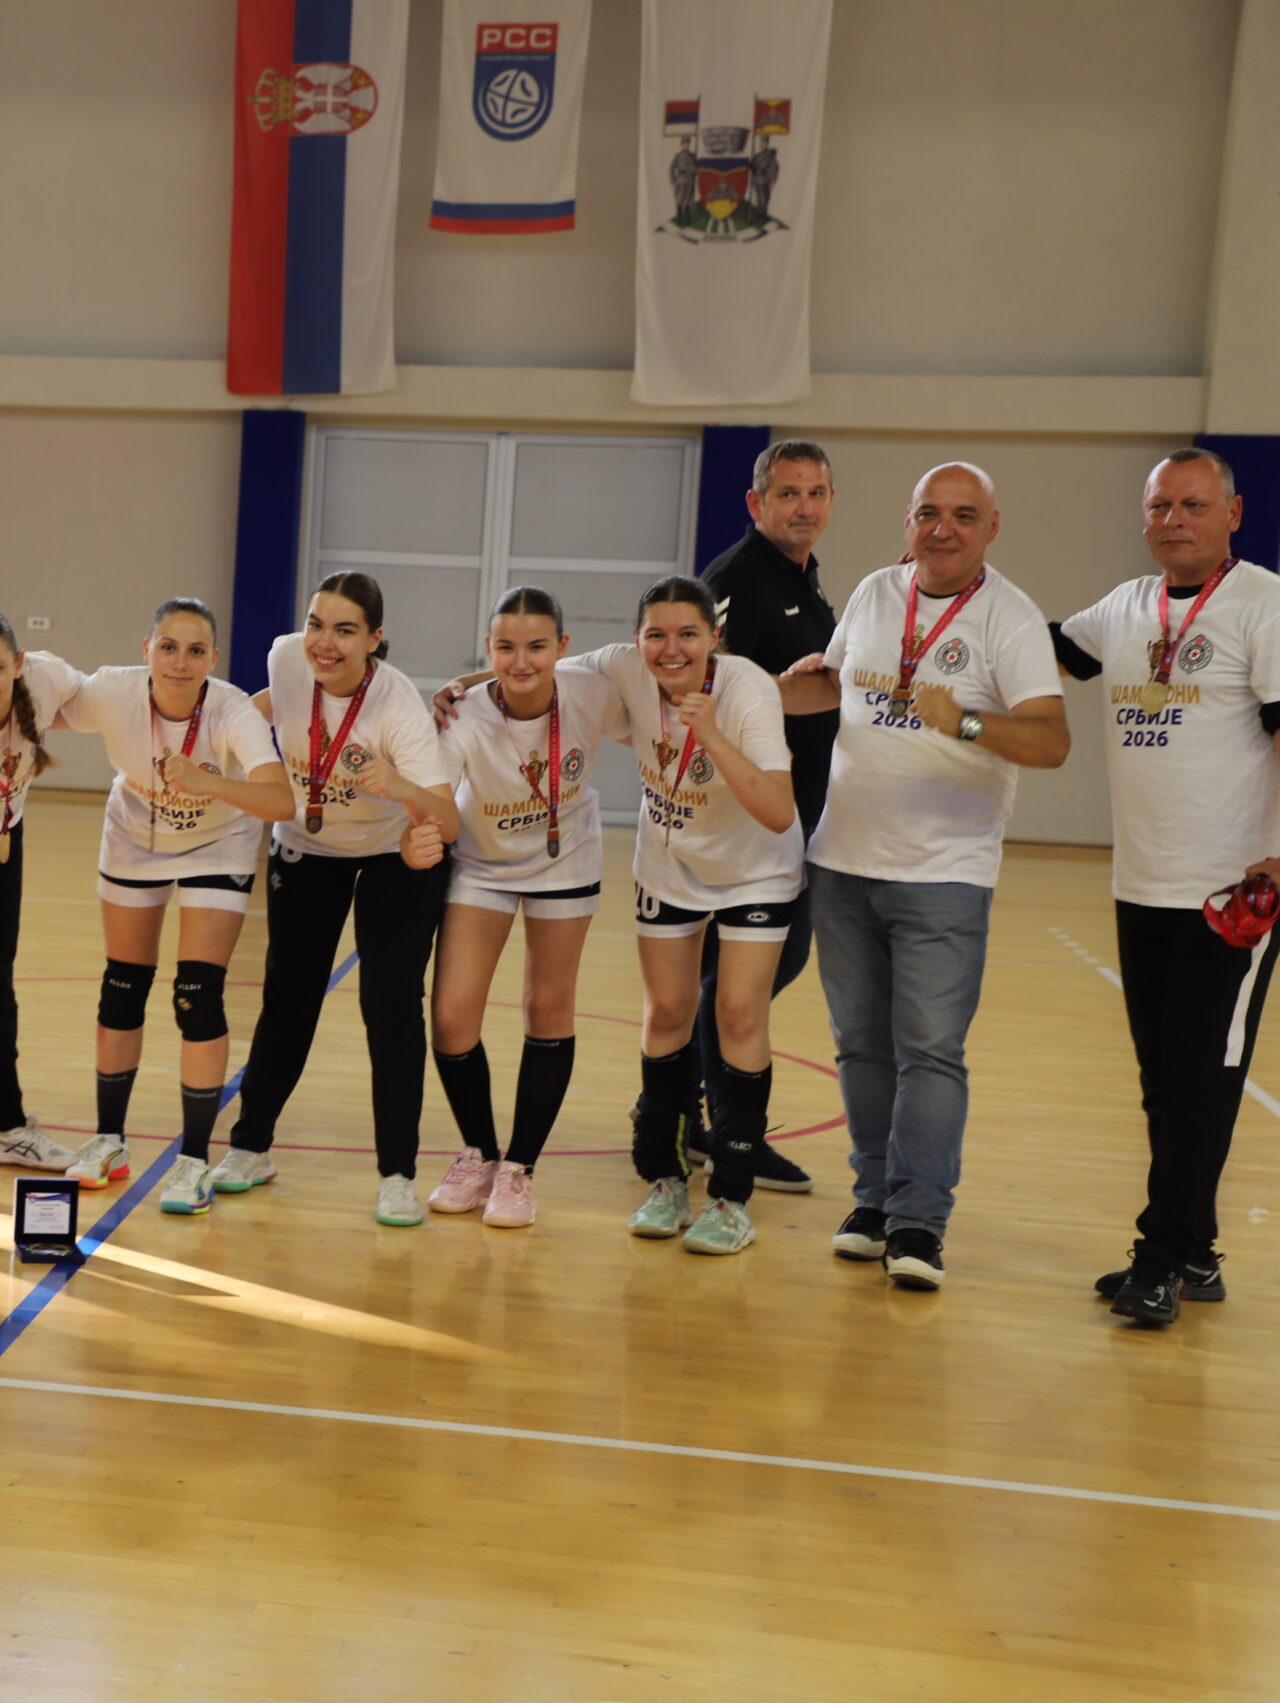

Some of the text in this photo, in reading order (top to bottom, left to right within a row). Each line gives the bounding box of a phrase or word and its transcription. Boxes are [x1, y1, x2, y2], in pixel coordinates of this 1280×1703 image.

[1111, 684, 1200, 705] ШАМОНИ
[872, 711, 922, 730] 2026
[1116, 708, 1183, 726] СРБИЈЕ
[1122, 729, 1169, 748] 2026
[483, 783, 581, 817] ШАМПИНИ
[641, 781, 695, 819] РБИЈЕ
[496, 811, 550, 830] СРБИ
